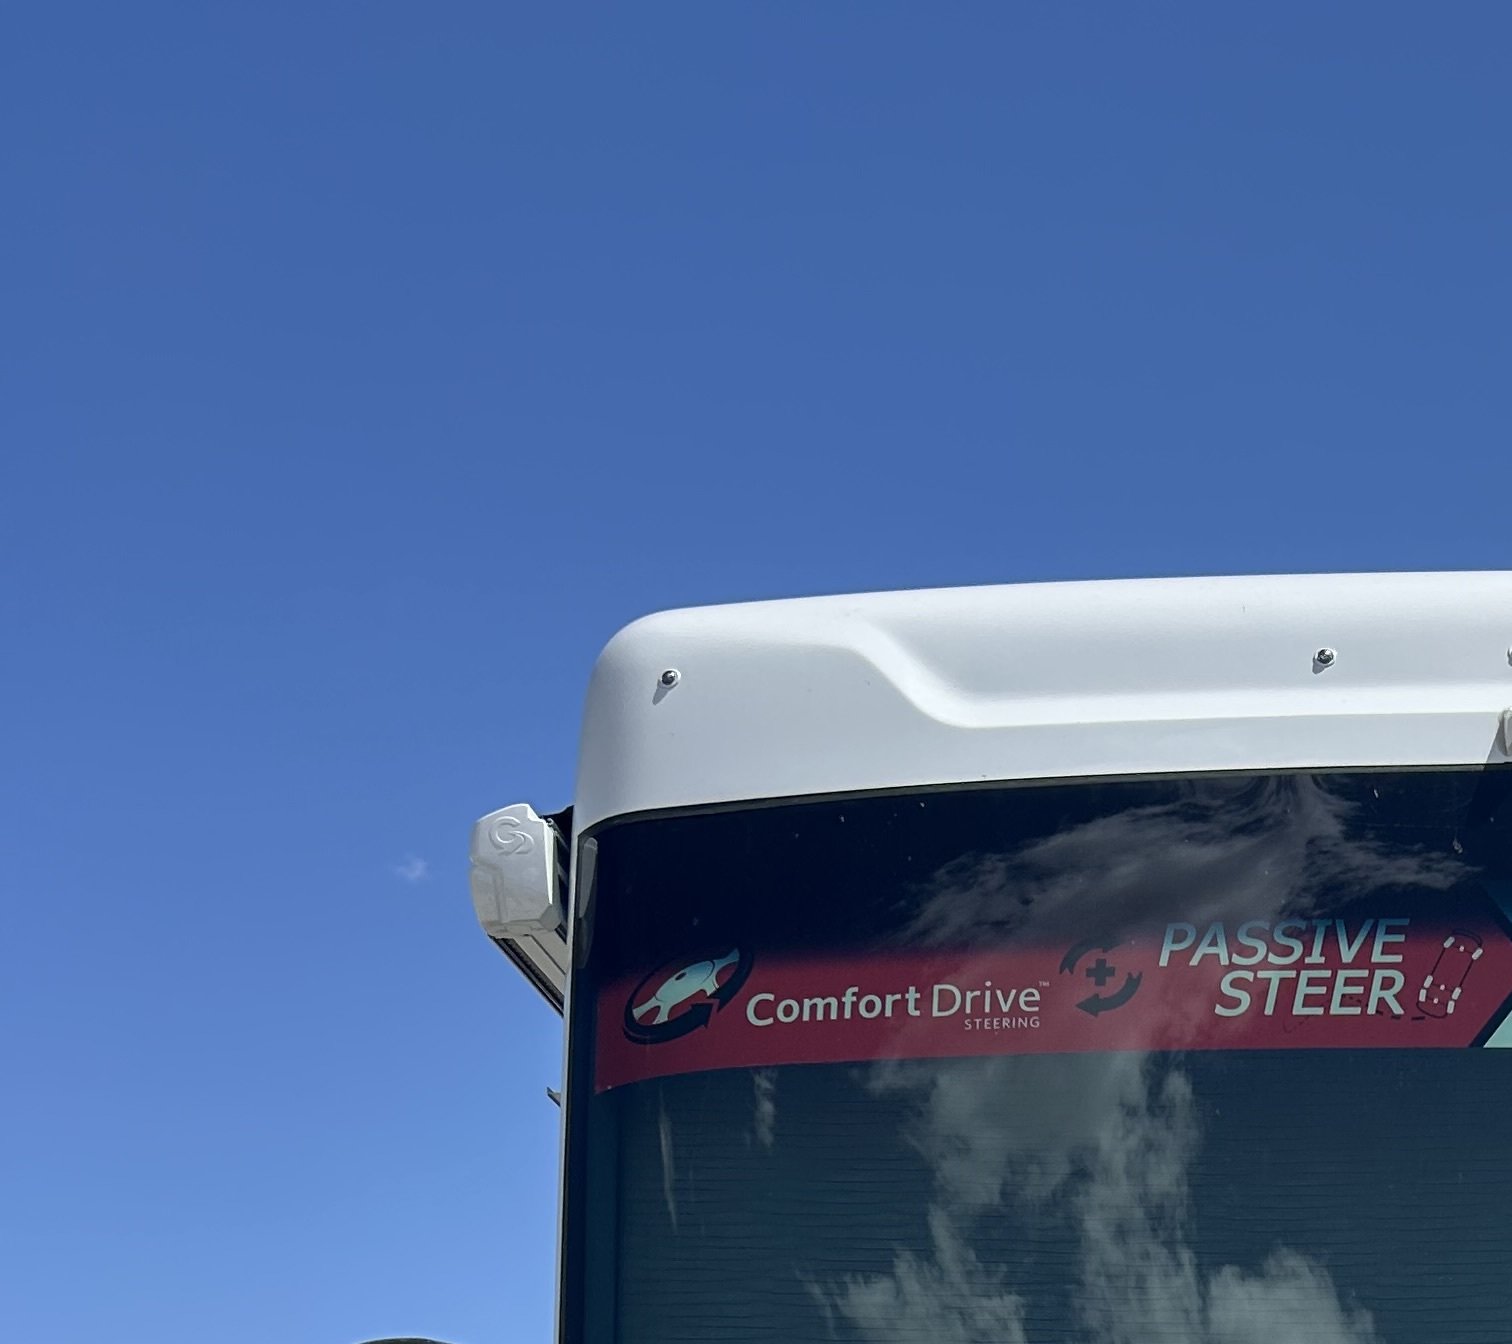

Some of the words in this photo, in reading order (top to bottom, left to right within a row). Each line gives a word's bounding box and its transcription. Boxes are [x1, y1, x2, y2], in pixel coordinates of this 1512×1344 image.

[1158, 918, 1410, 968] PASSIVE
[745, 985, 921, 1027] Comfort
[1214, 969, 1405, 1017] STEER
[963, 1016, 1040, 1031] STEERING
